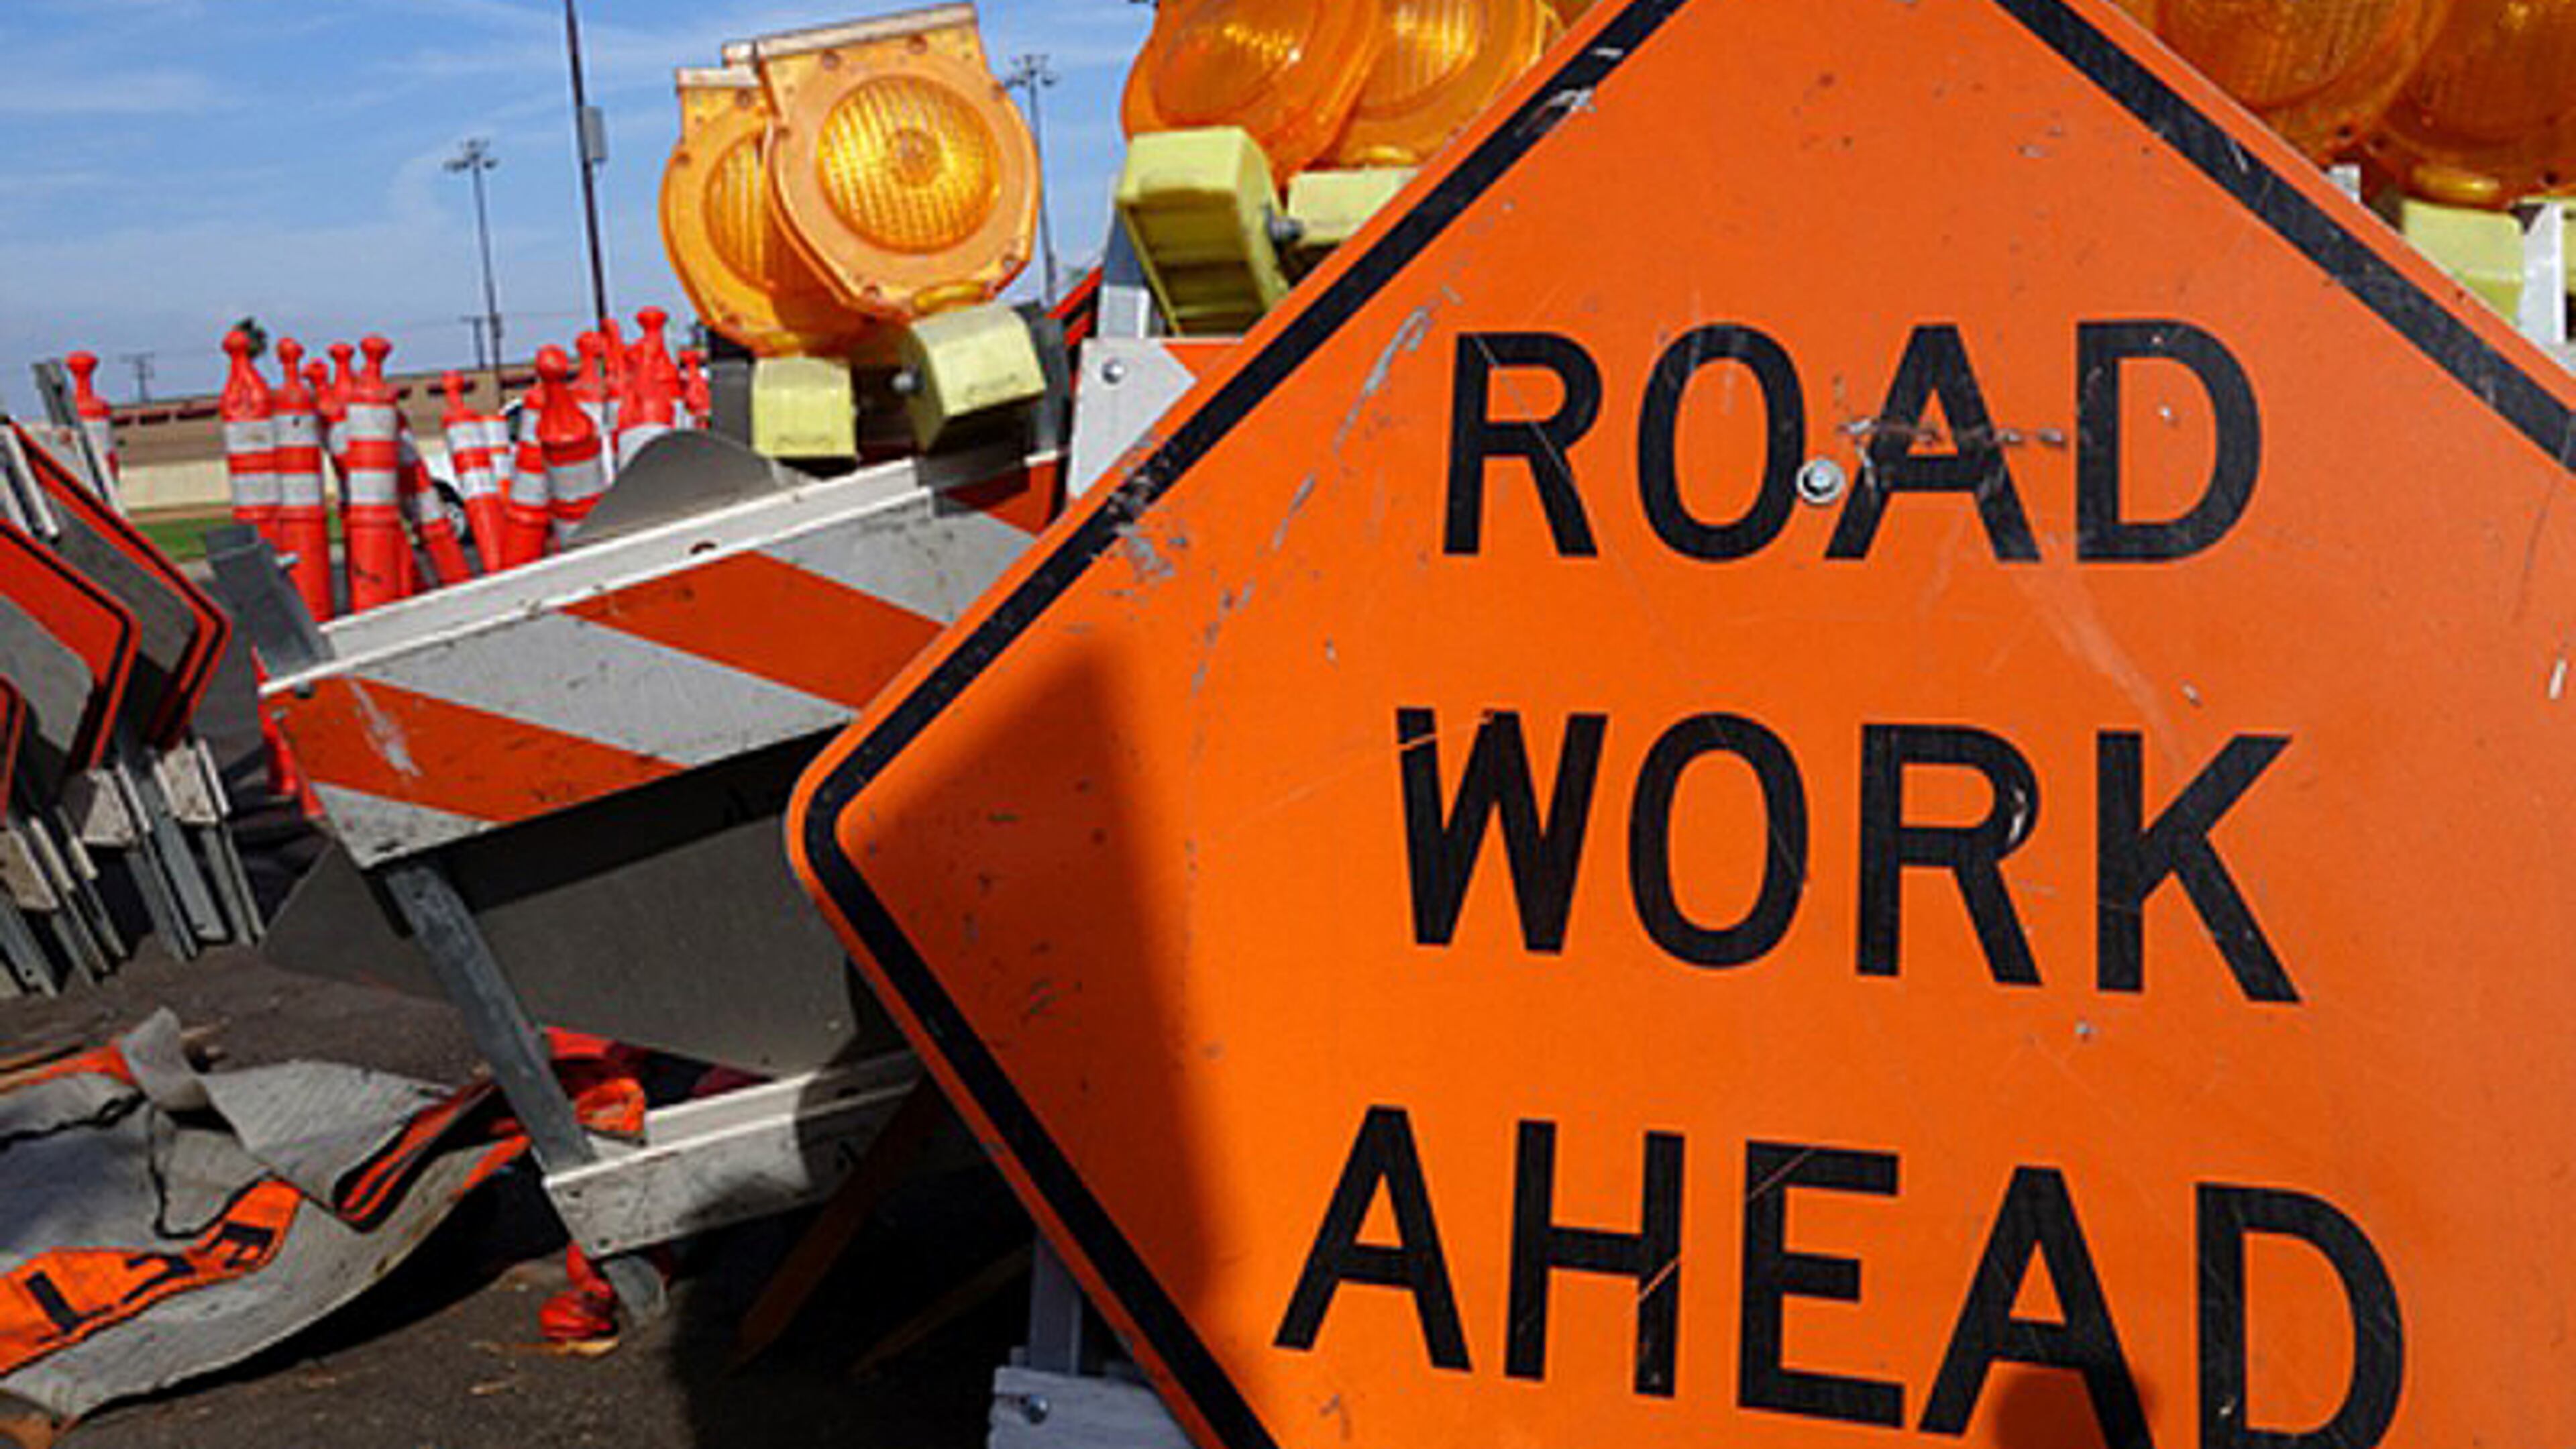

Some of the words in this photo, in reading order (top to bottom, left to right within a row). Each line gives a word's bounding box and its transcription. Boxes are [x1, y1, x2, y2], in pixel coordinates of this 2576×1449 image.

[1442, 319, 2263, 564] ROAD
[1397, 708, 2302, 1004] WORK
[1274, 1104, 2406, 1449] AHEAD
